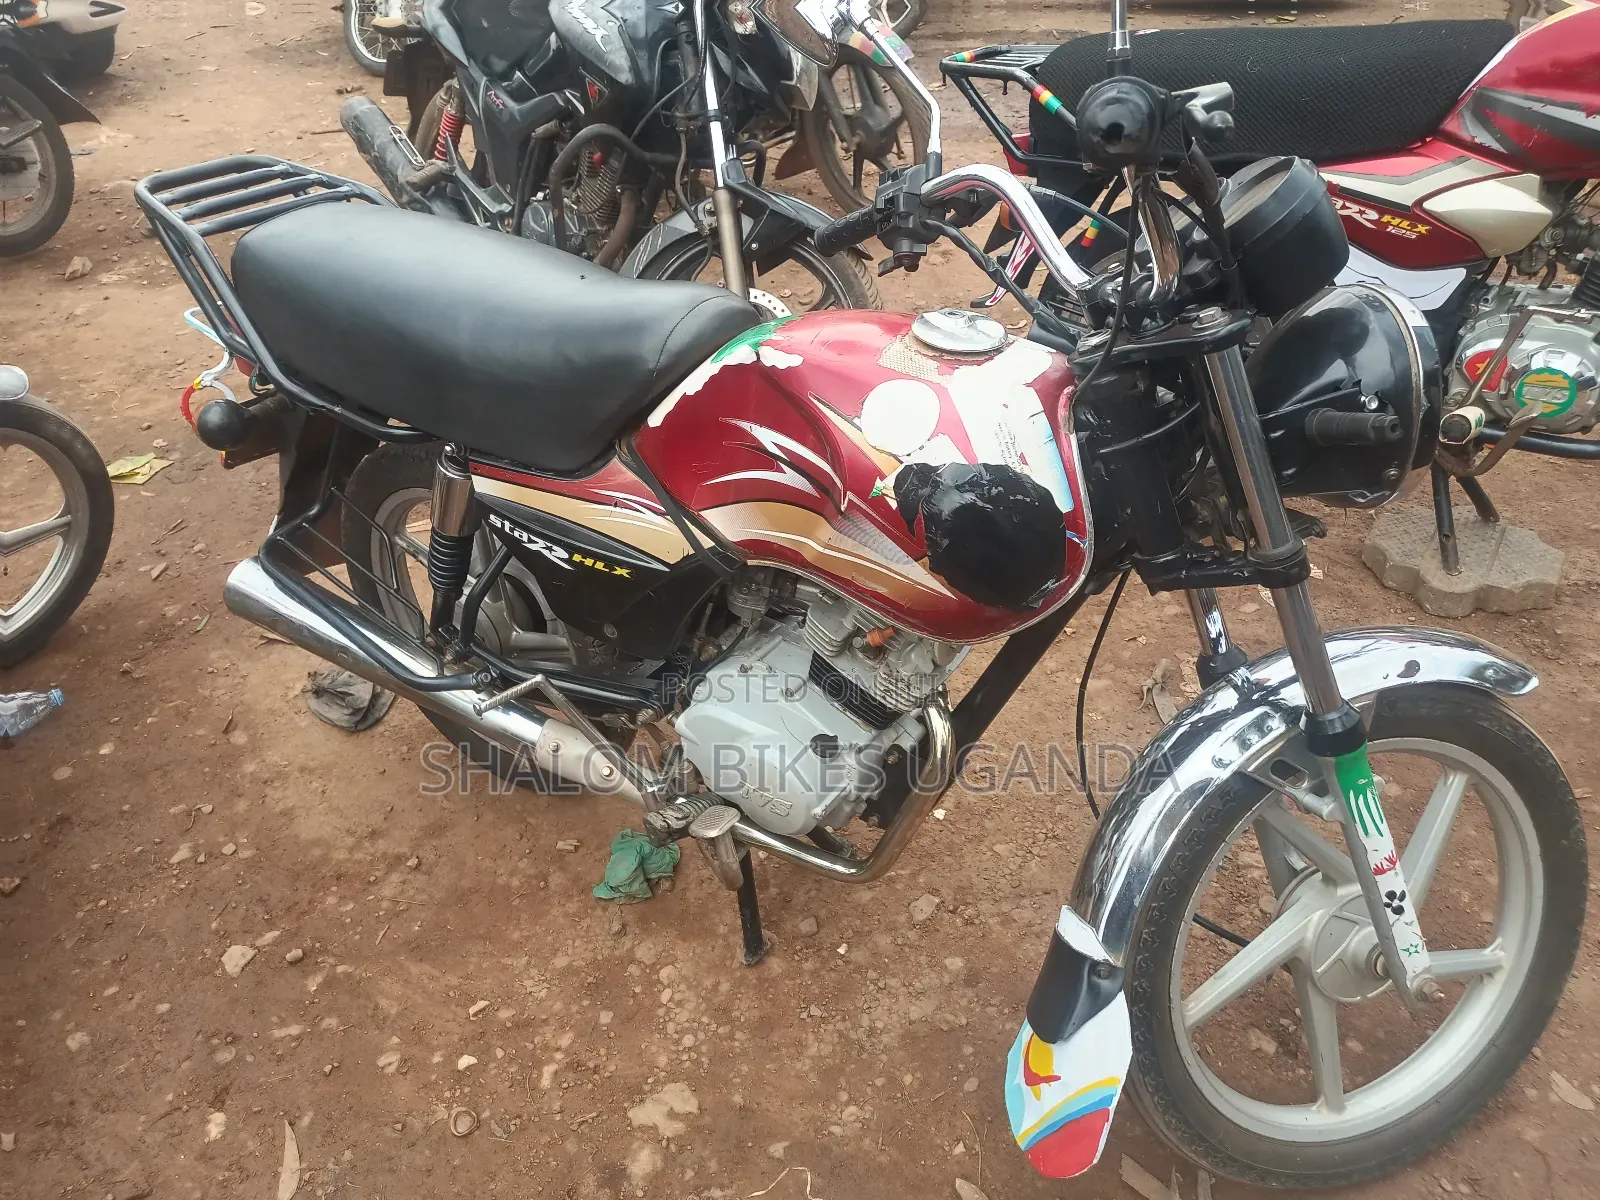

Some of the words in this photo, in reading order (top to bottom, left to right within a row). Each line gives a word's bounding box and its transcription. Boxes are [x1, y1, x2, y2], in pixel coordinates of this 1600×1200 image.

[1380, 214, 1431, 234] HLX
[1386, 225, 1419, 239] 125
[572, 553, 634, 579] HLX
[739, 779, 793, 817] TVS
